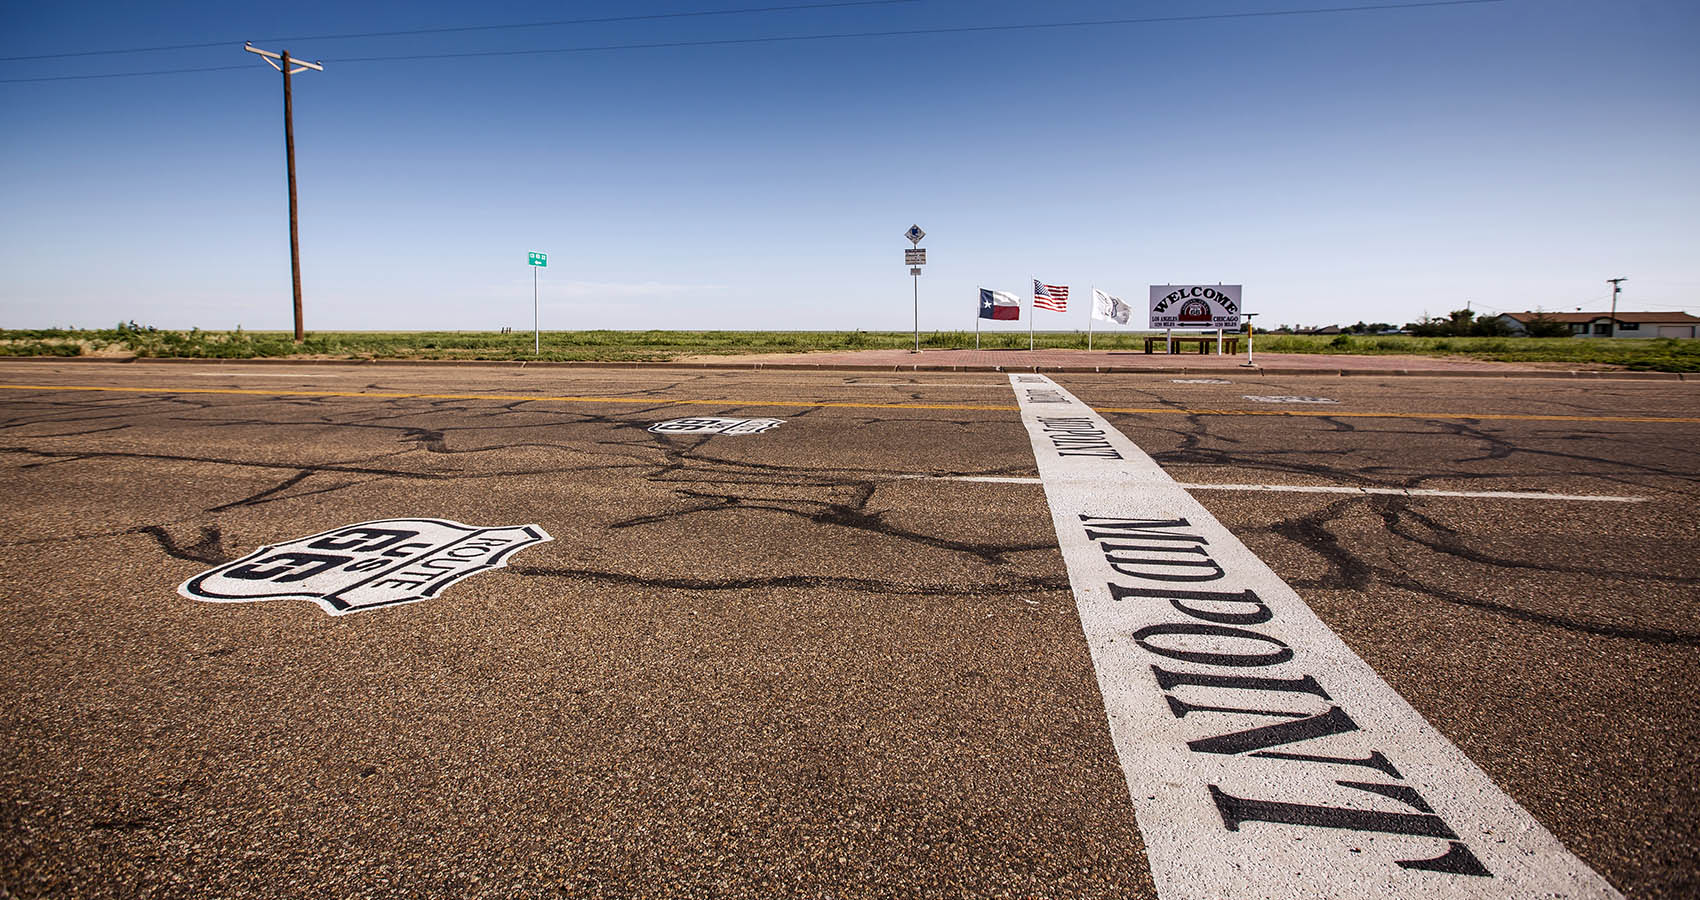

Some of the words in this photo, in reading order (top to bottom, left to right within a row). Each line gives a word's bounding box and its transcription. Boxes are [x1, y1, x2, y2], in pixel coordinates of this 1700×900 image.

[1153, 287, 1238, 314] WELCOME
[1036, 416, 1124, 460] MIDPOINT
[223, 527, 419, 583] 66
[344, 542, 432, 573] US
[372, 537, 512, 591] ROUTE
[1078, 513, 1493, 878] MIDPOINT
